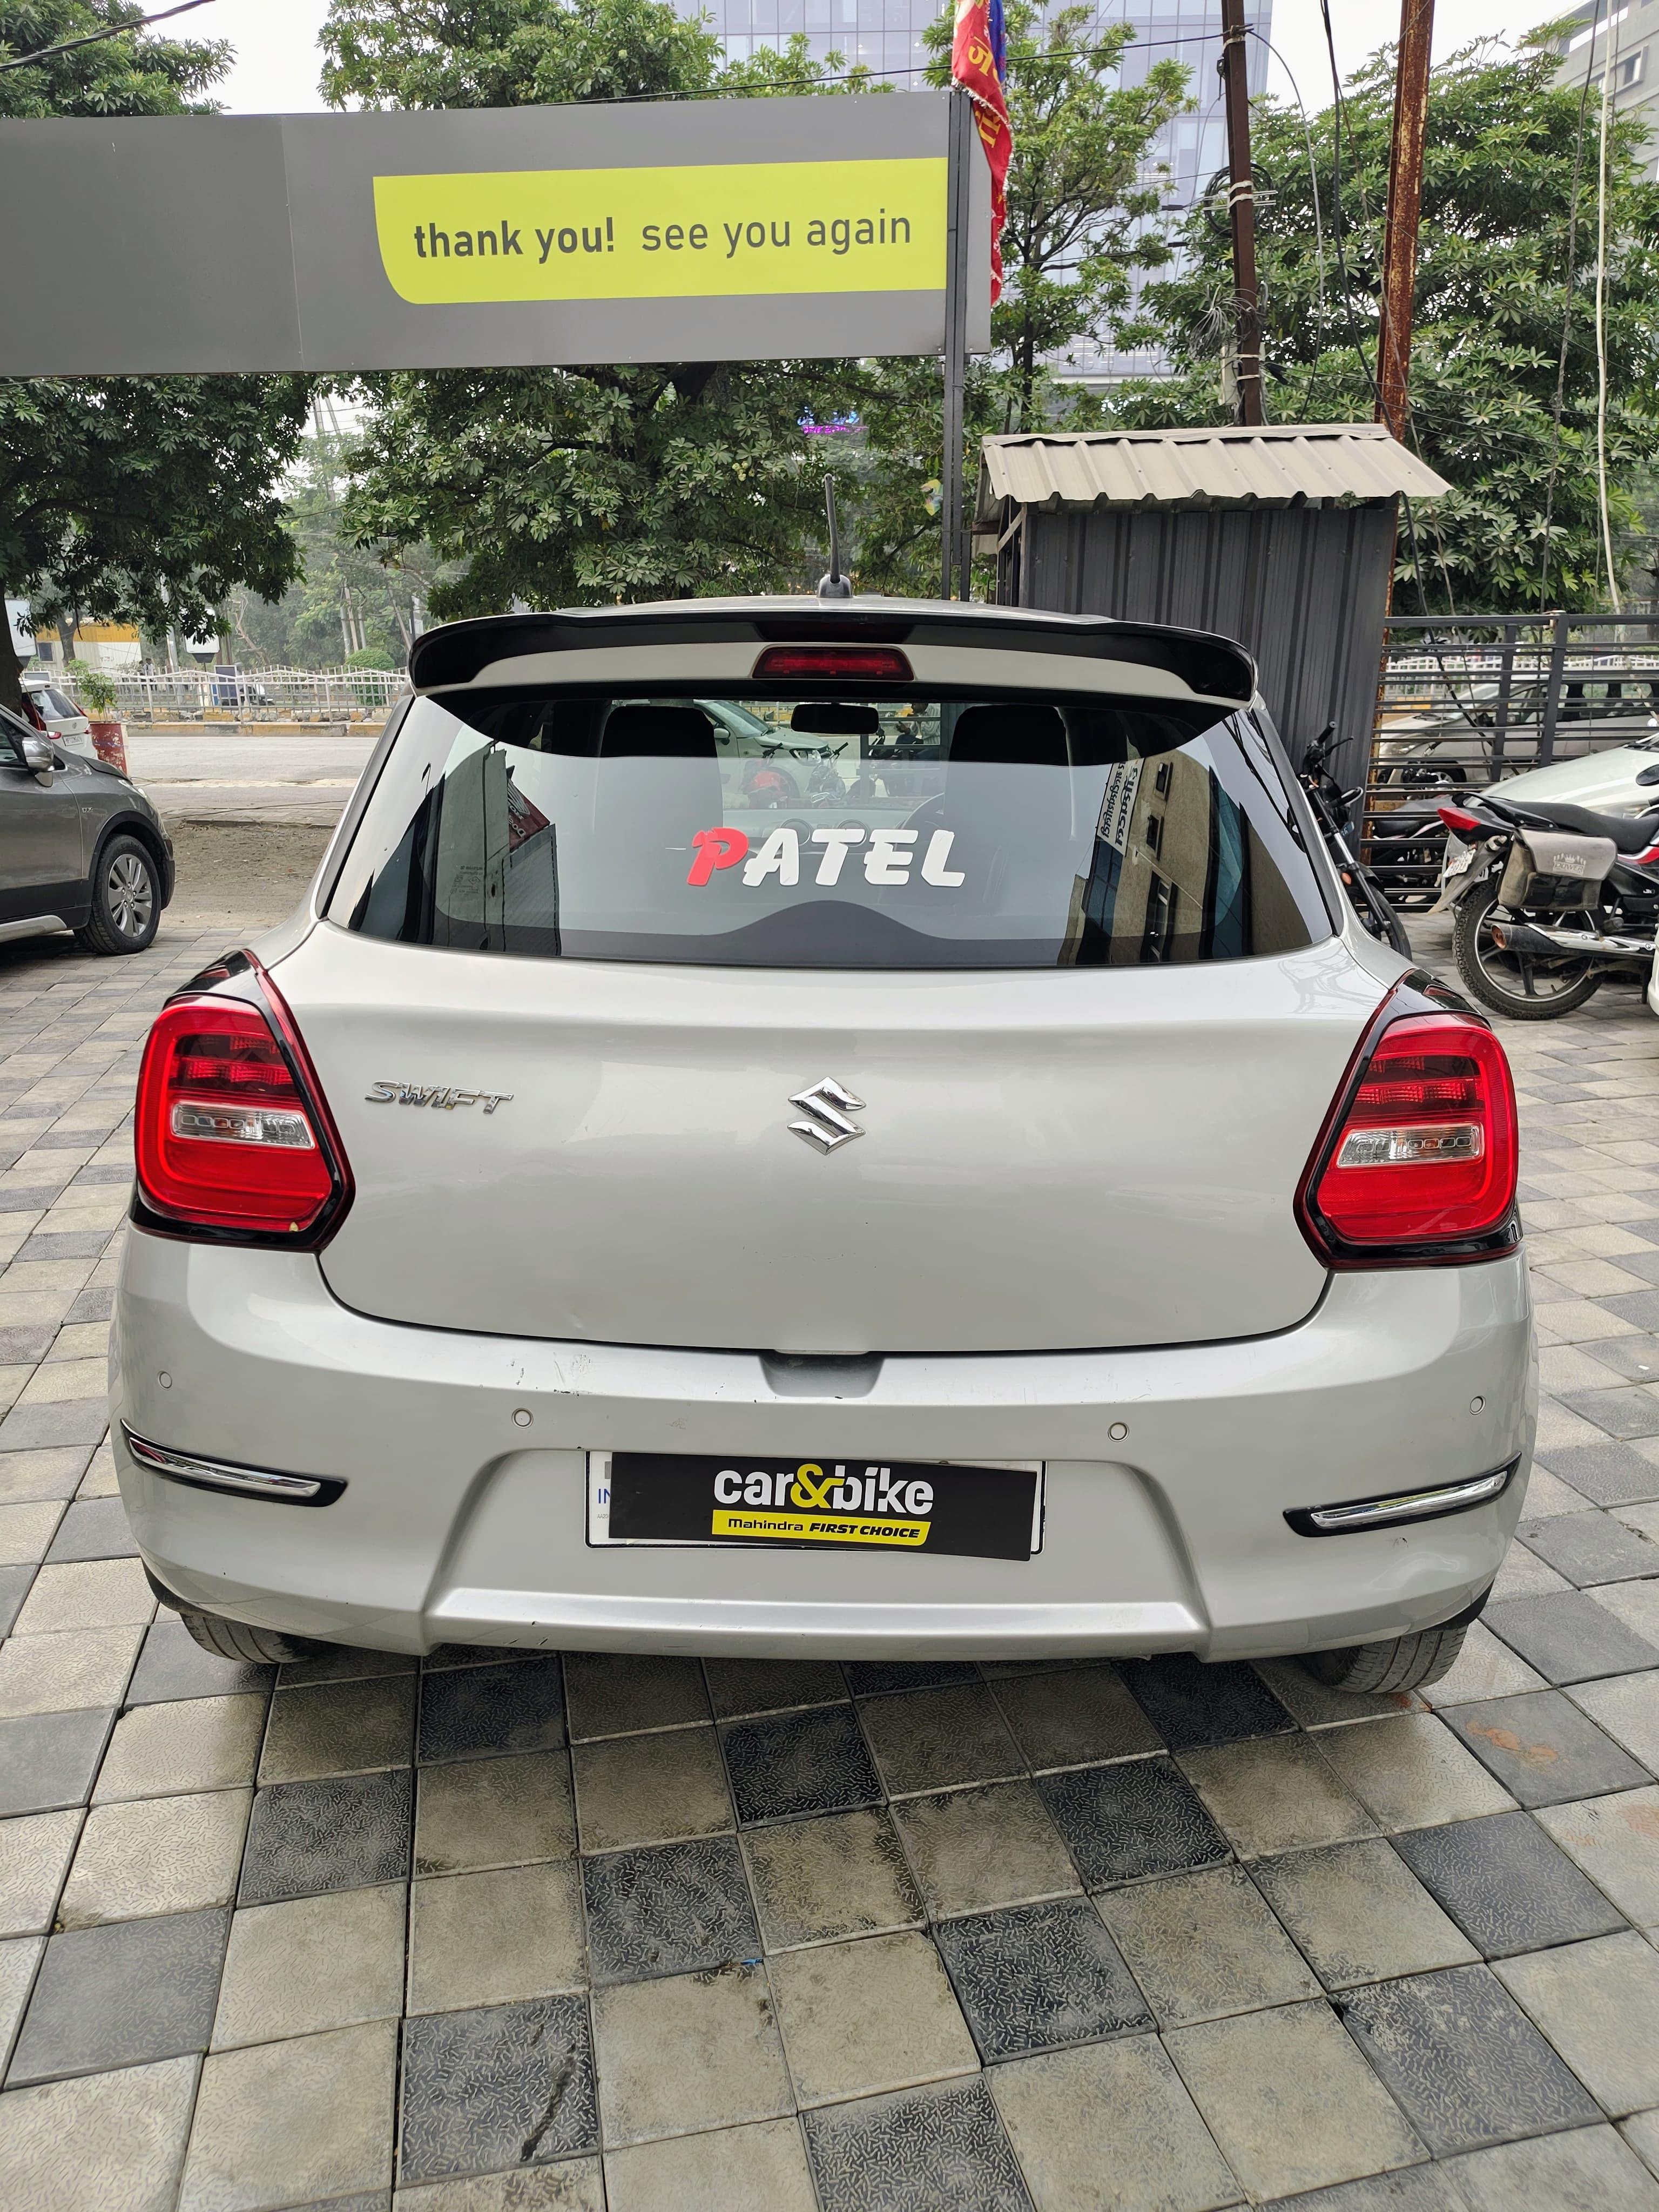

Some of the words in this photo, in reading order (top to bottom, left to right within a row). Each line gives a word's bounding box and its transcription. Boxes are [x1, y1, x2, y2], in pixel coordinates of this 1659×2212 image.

[414, 220, 523, 258] thank
[535, 217, 614, 265] you!
[642, 224, 708, 251] see
[723, 221, 790, 259] you
[807, 208, 910, 255] again
[686, 827, 966, 887] PATEL
[365, 1080, 514, 1115] SWIFT
[598, 1488, 610, 1504] IN
[713, 1463, 934, 1515] car&bike
[728, 1518, 804, 1531] Mahindra
[809, 1522, 859, 1535] FIRST
[859, 1525, 921, 1538] CHOICE
